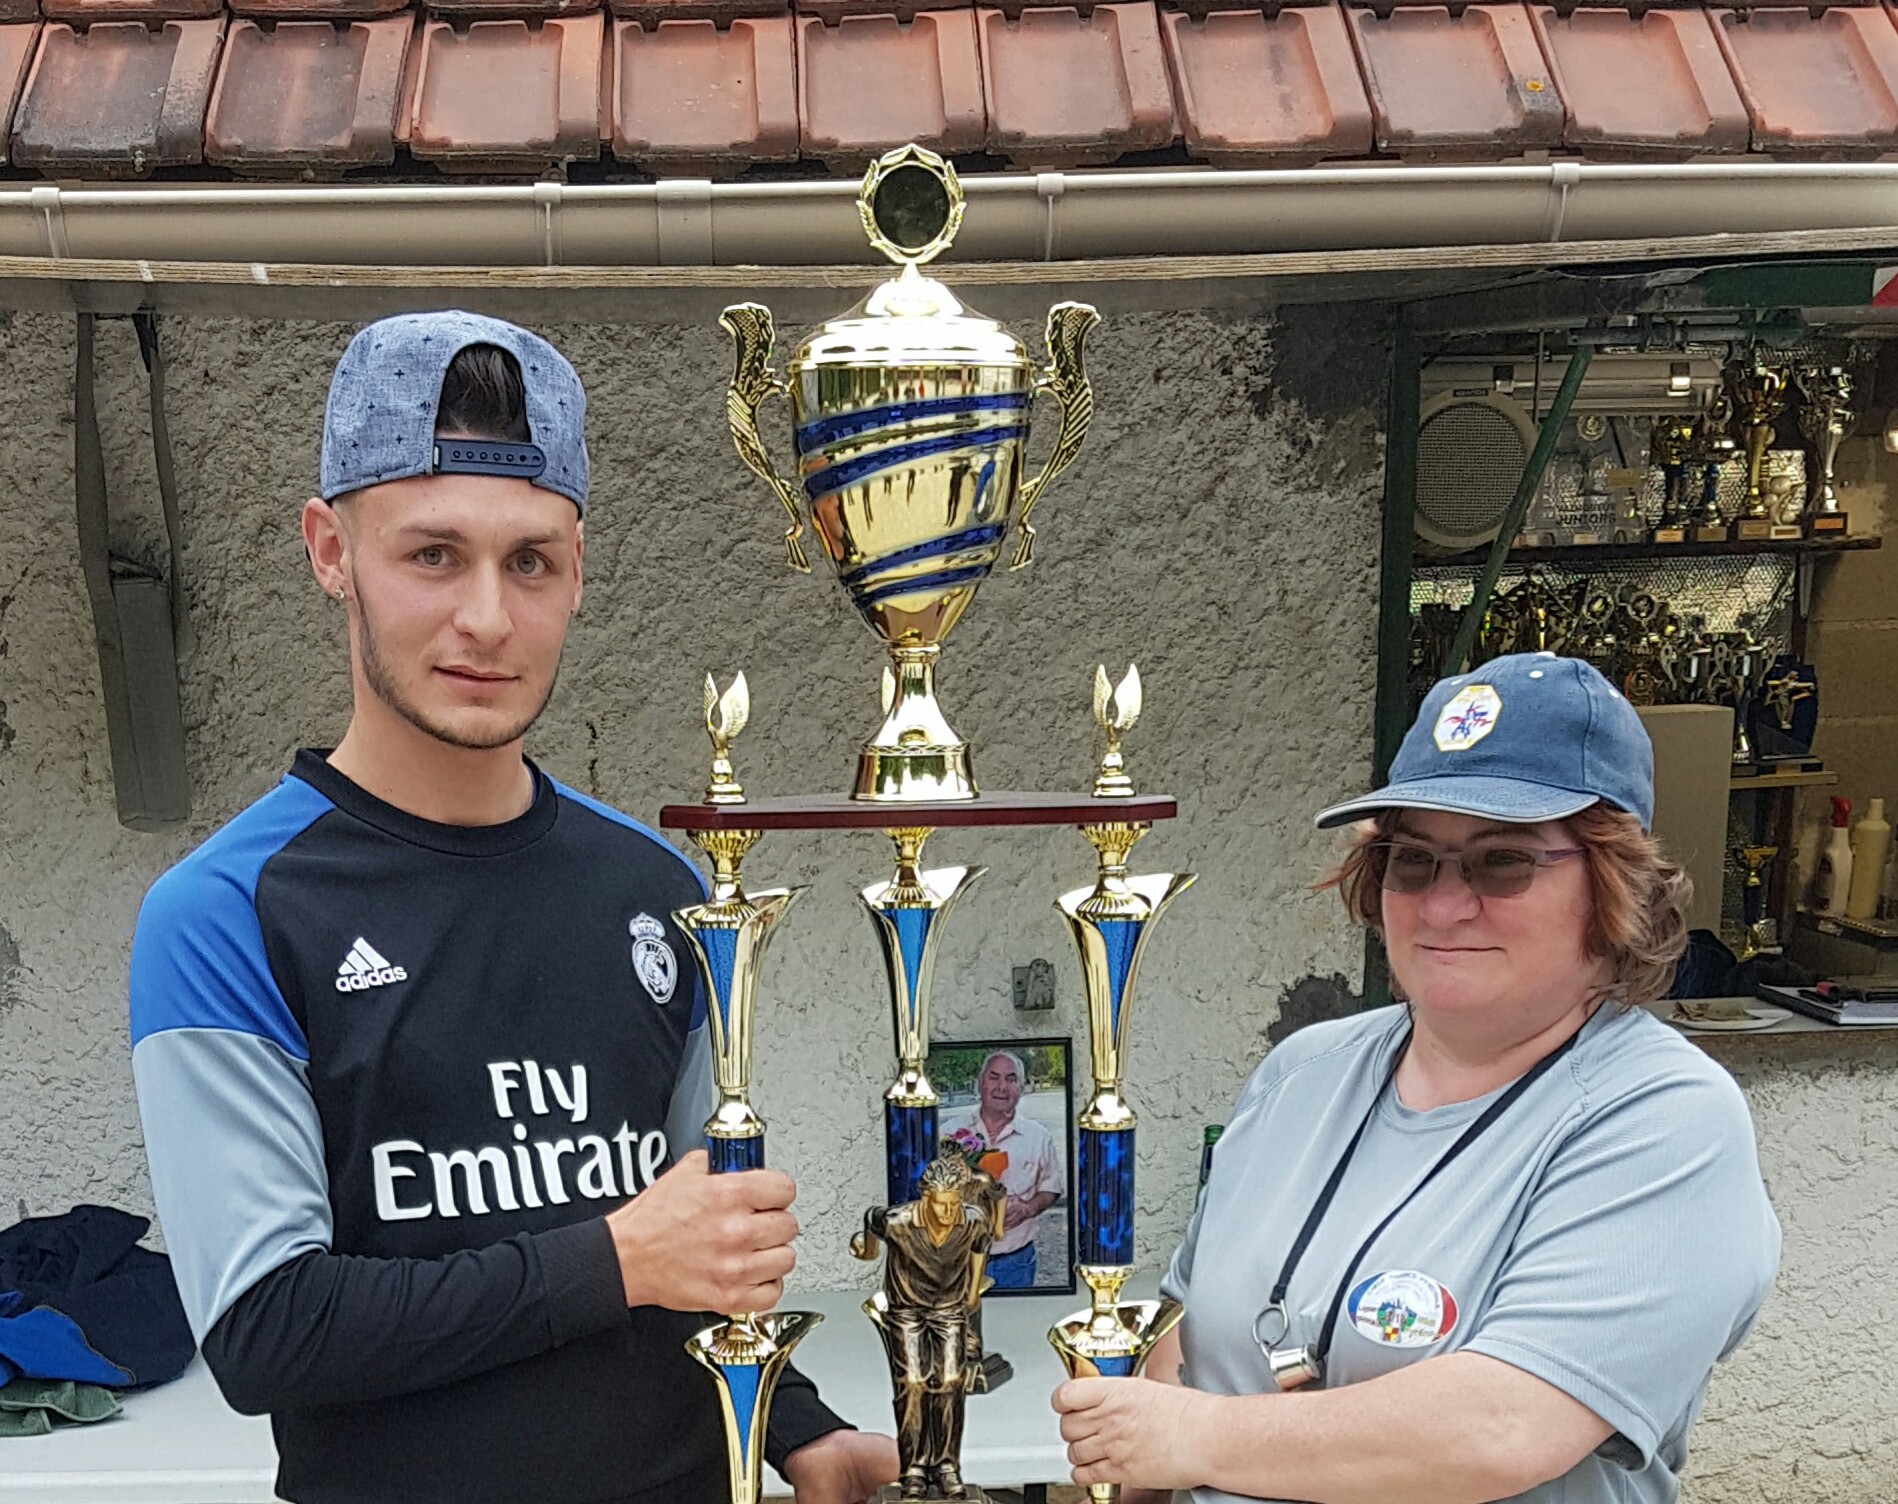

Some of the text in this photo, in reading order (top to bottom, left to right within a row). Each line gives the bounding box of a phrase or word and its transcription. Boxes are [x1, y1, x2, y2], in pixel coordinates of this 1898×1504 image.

[1556, 512, 1617, 525] JUNIORS
[335, 966, 408, 992] adidas
[487, 1060, 587, 1122] Fly
[371, 1120, 667, 1221] Emirate
